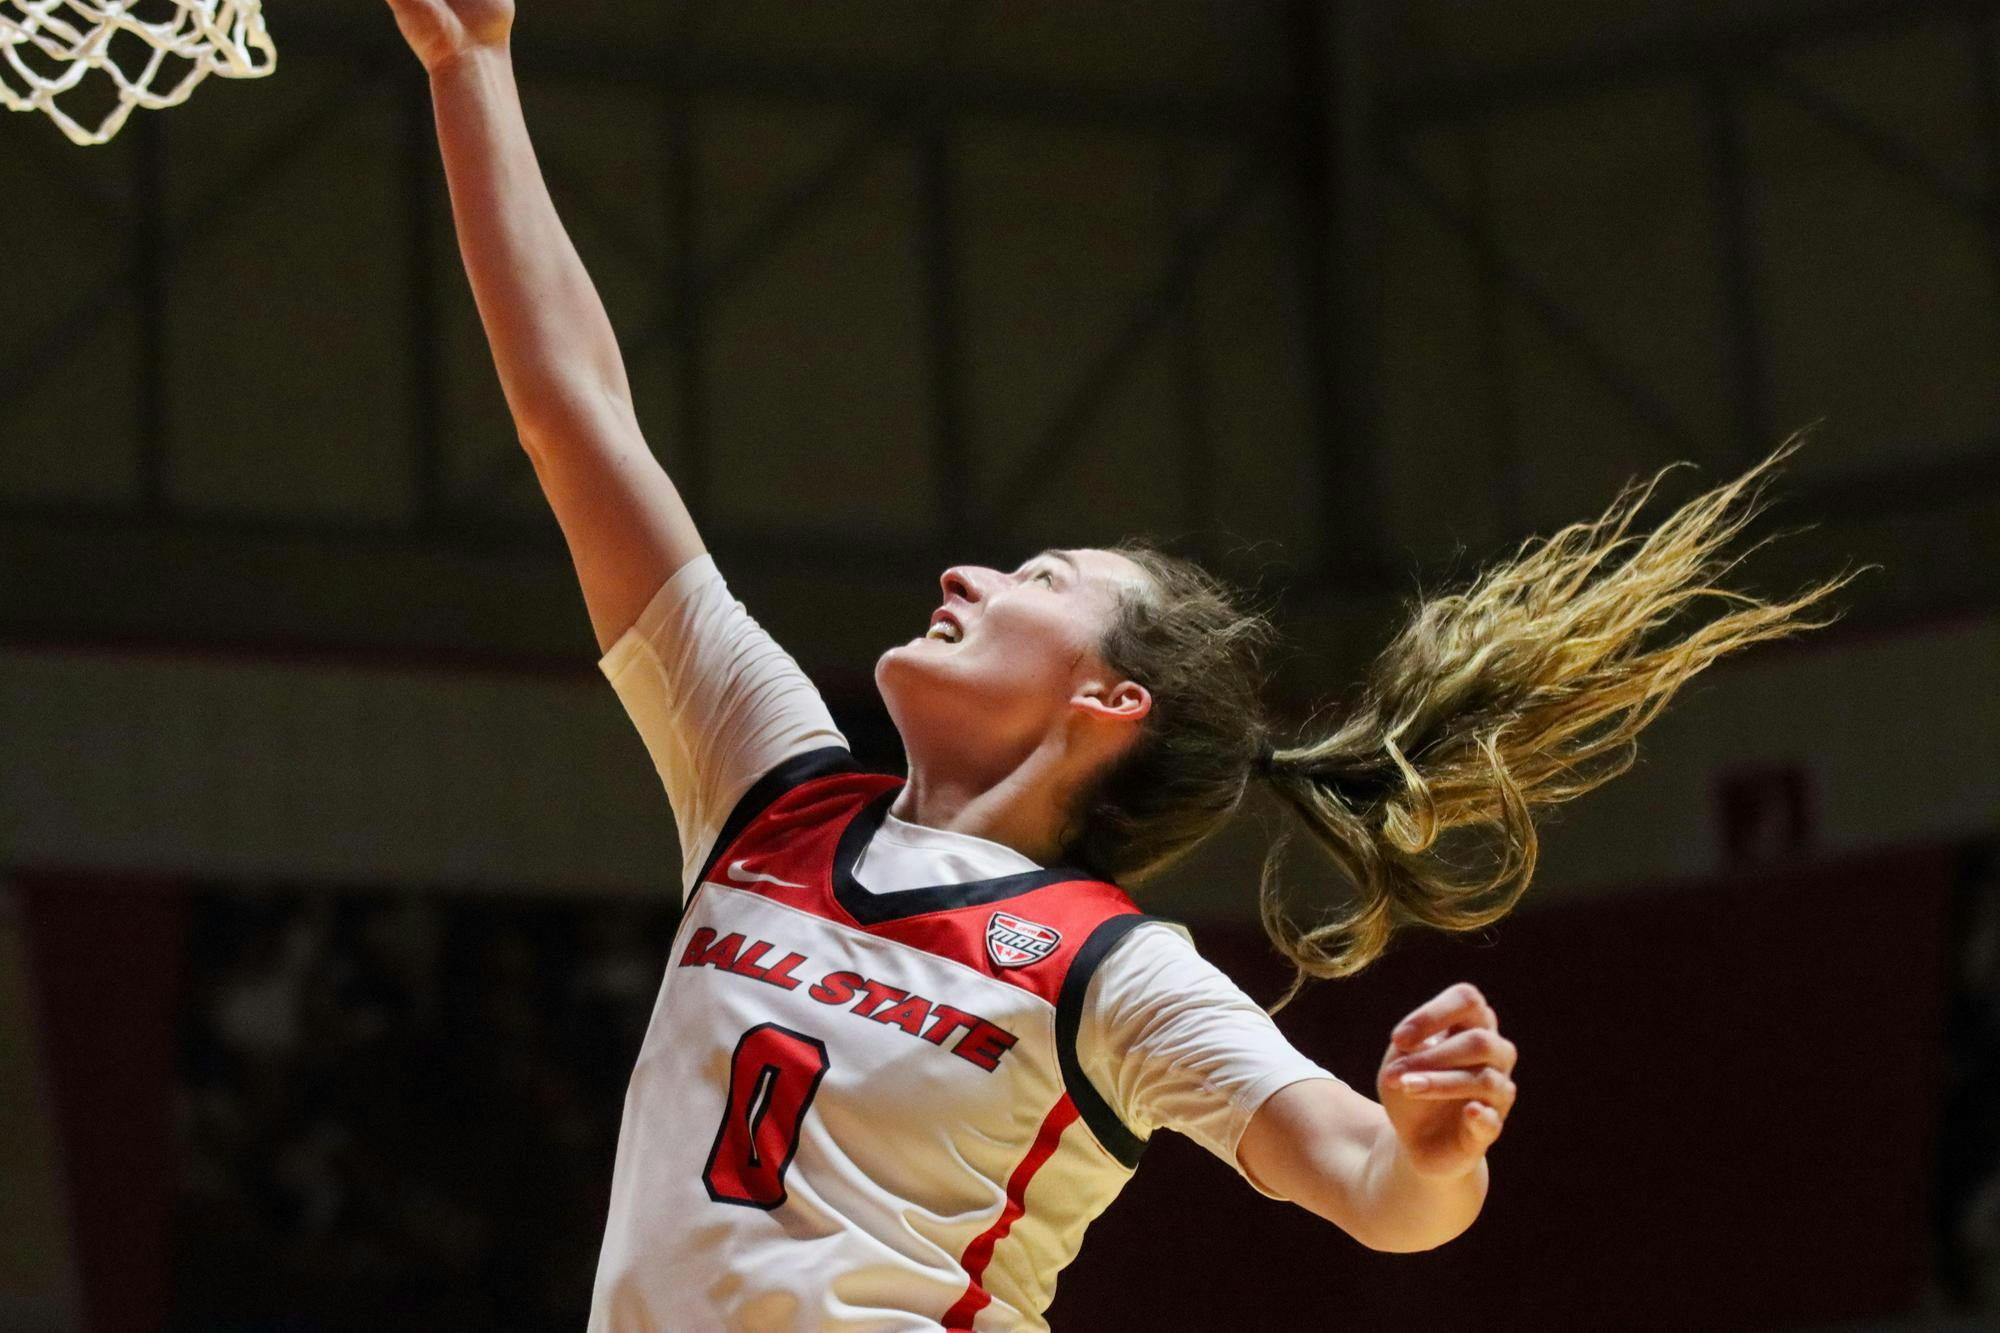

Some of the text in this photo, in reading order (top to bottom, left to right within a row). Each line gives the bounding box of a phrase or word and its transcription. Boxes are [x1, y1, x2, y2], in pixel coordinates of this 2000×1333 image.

[678, 926, 1019, 1073] BALL STATE
[989, 924, 1053, 957] MAC
[702, 1022, 830, 1211] 0
